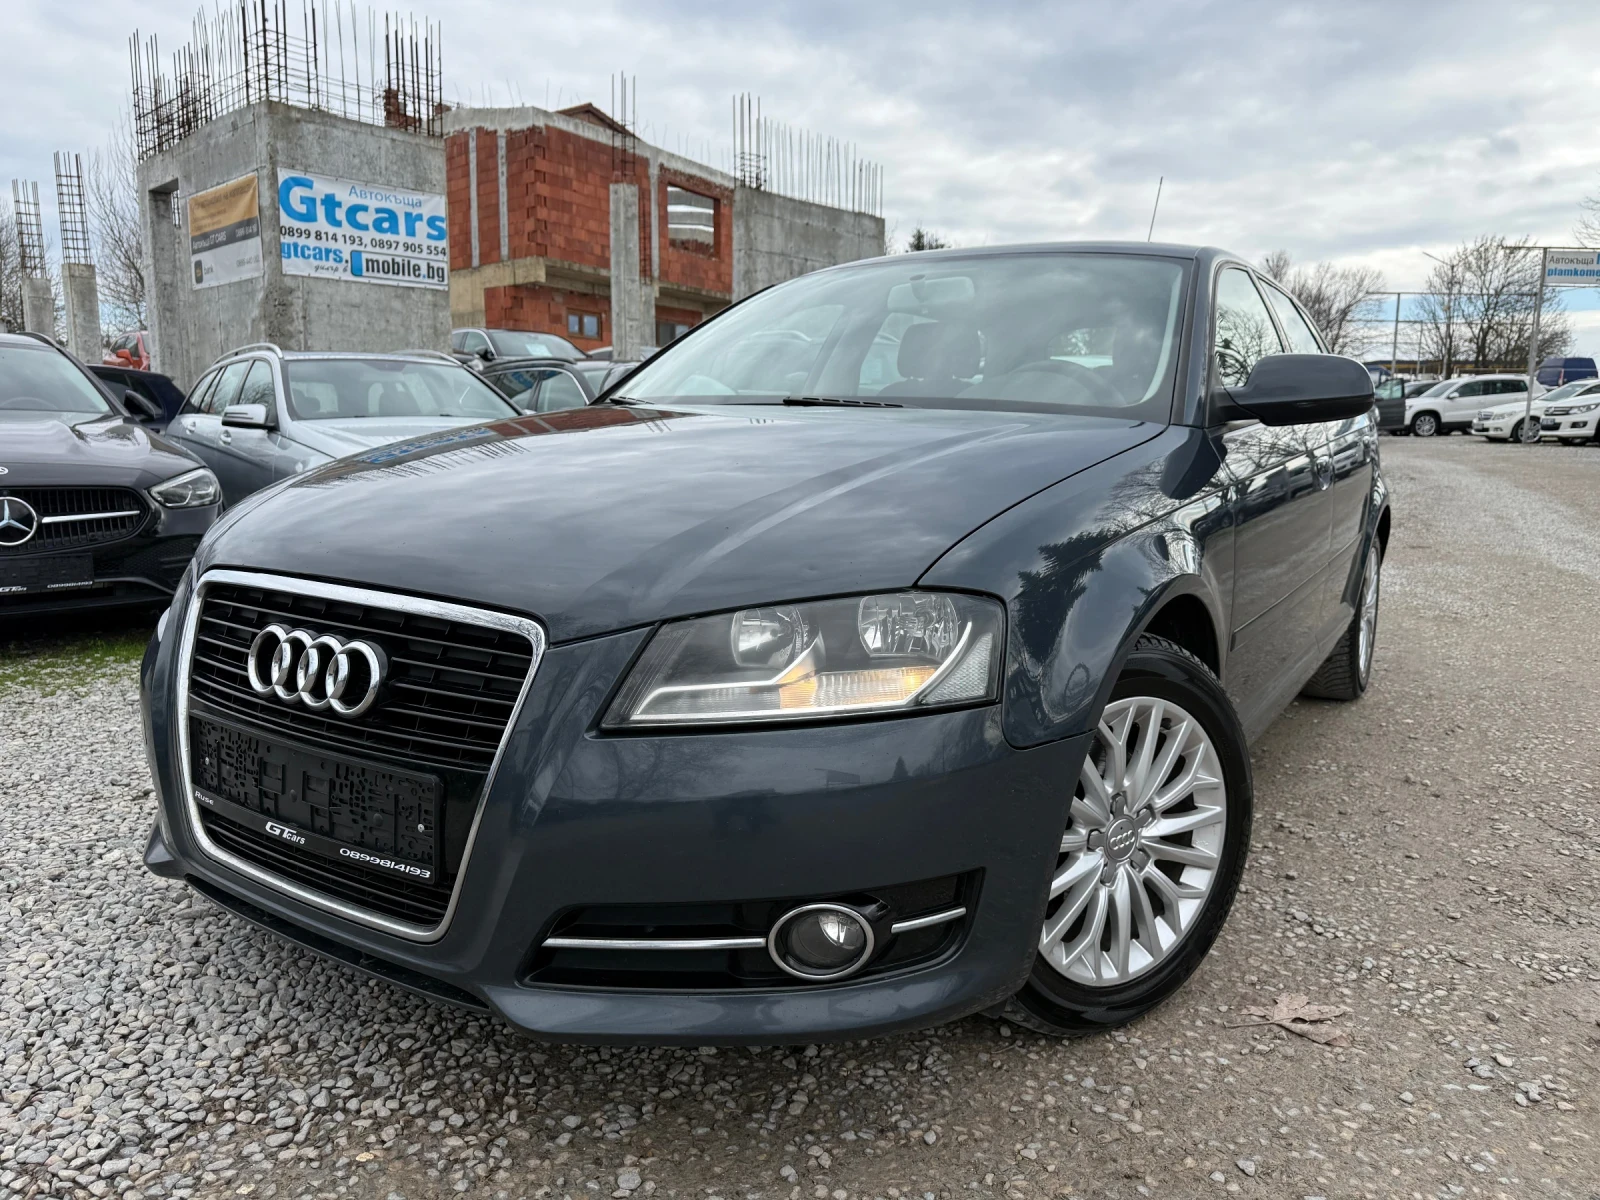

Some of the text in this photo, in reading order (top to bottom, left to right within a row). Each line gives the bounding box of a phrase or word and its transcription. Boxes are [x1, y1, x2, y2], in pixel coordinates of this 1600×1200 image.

[279, 176, 447, 241] Gtcars
[349, 185, 422, 208] Автокъща
[280, 225, 447, 257] 0899 814 193, 0897 905 554
[365, 257, 446, 283] mobile.bg
[1548, 255, 1594, 266] Автокъща
[194, 790, 214, 805] Ruse
[339, 847, 431, 878] 0899814193
